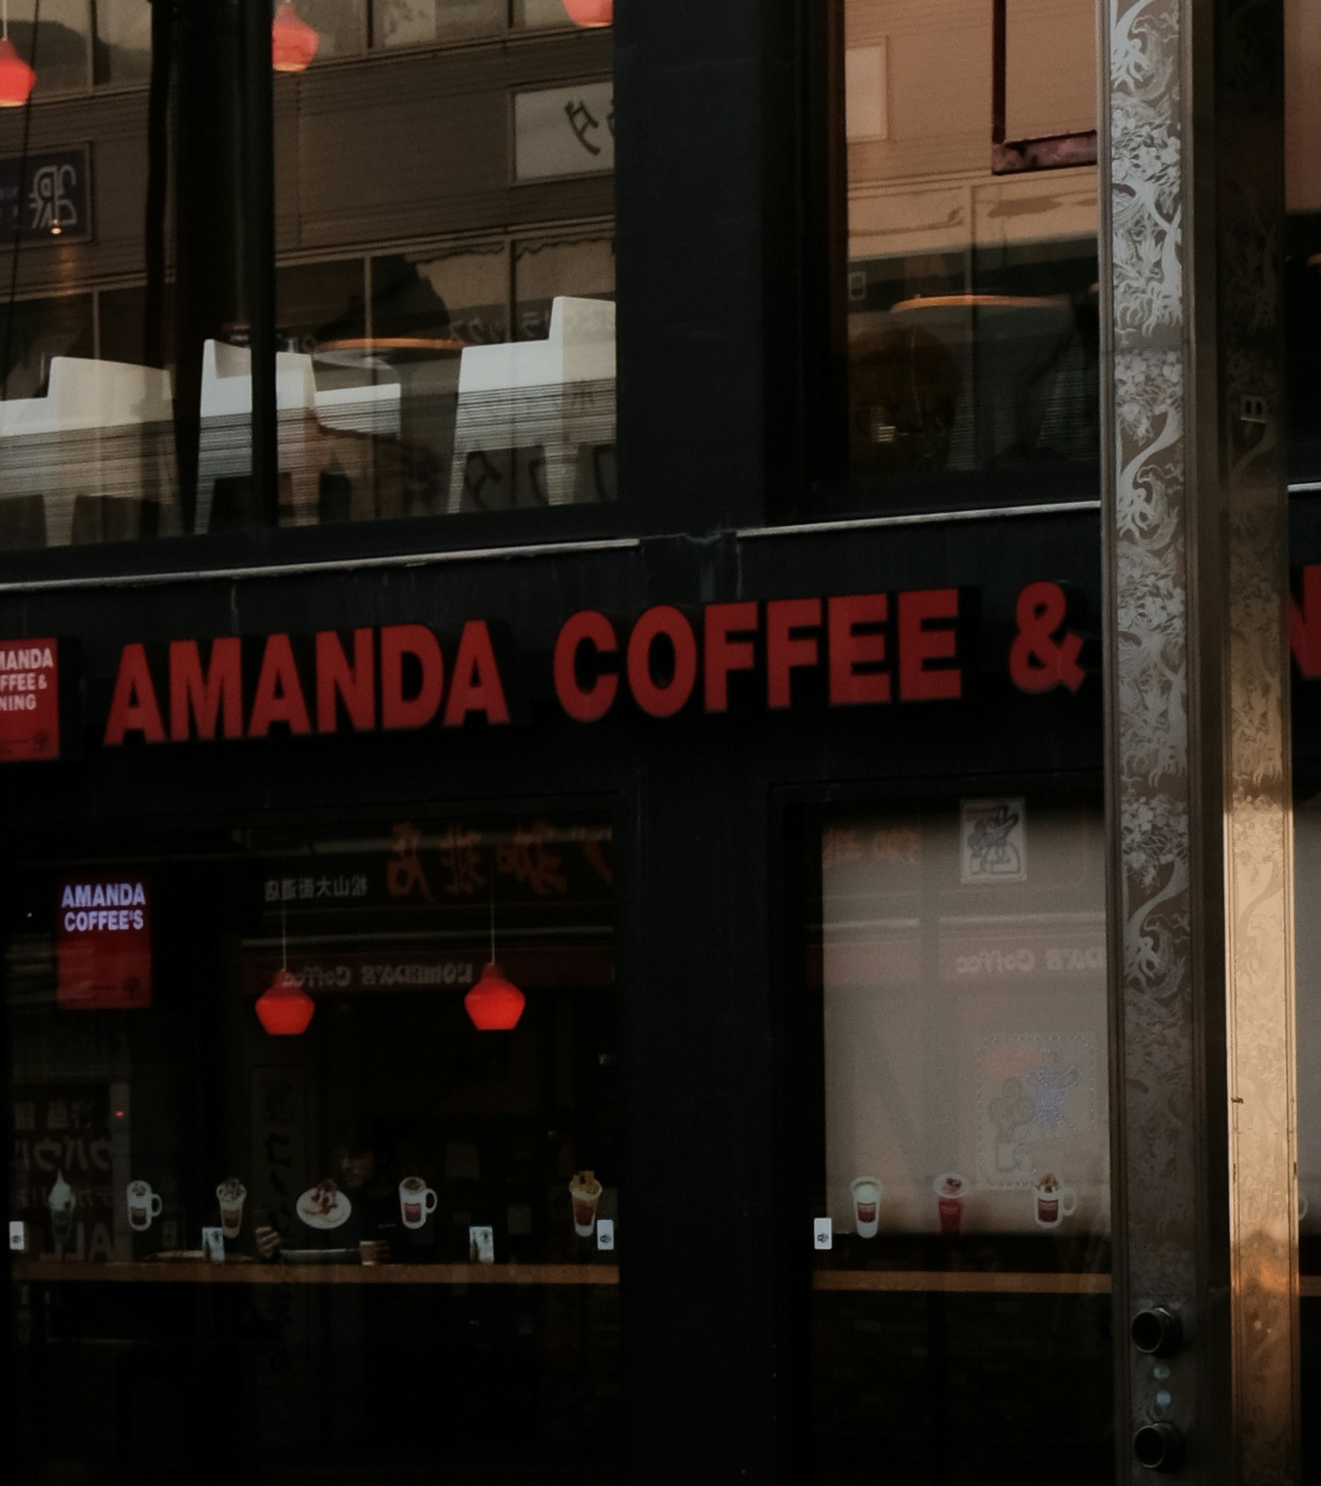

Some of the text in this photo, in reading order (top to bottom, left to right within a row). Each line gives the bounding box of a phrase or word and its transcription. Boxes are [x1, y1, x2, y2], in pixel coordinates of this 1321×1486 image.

[101, 618, 512, 747] AMANDA
[553, 586, 964, 724] COFFEE
[1007, 579, 1089, 697] &
[62, 881, 147, 908] AMANDA
[64, 909, 144, 932] COFFEE'S
